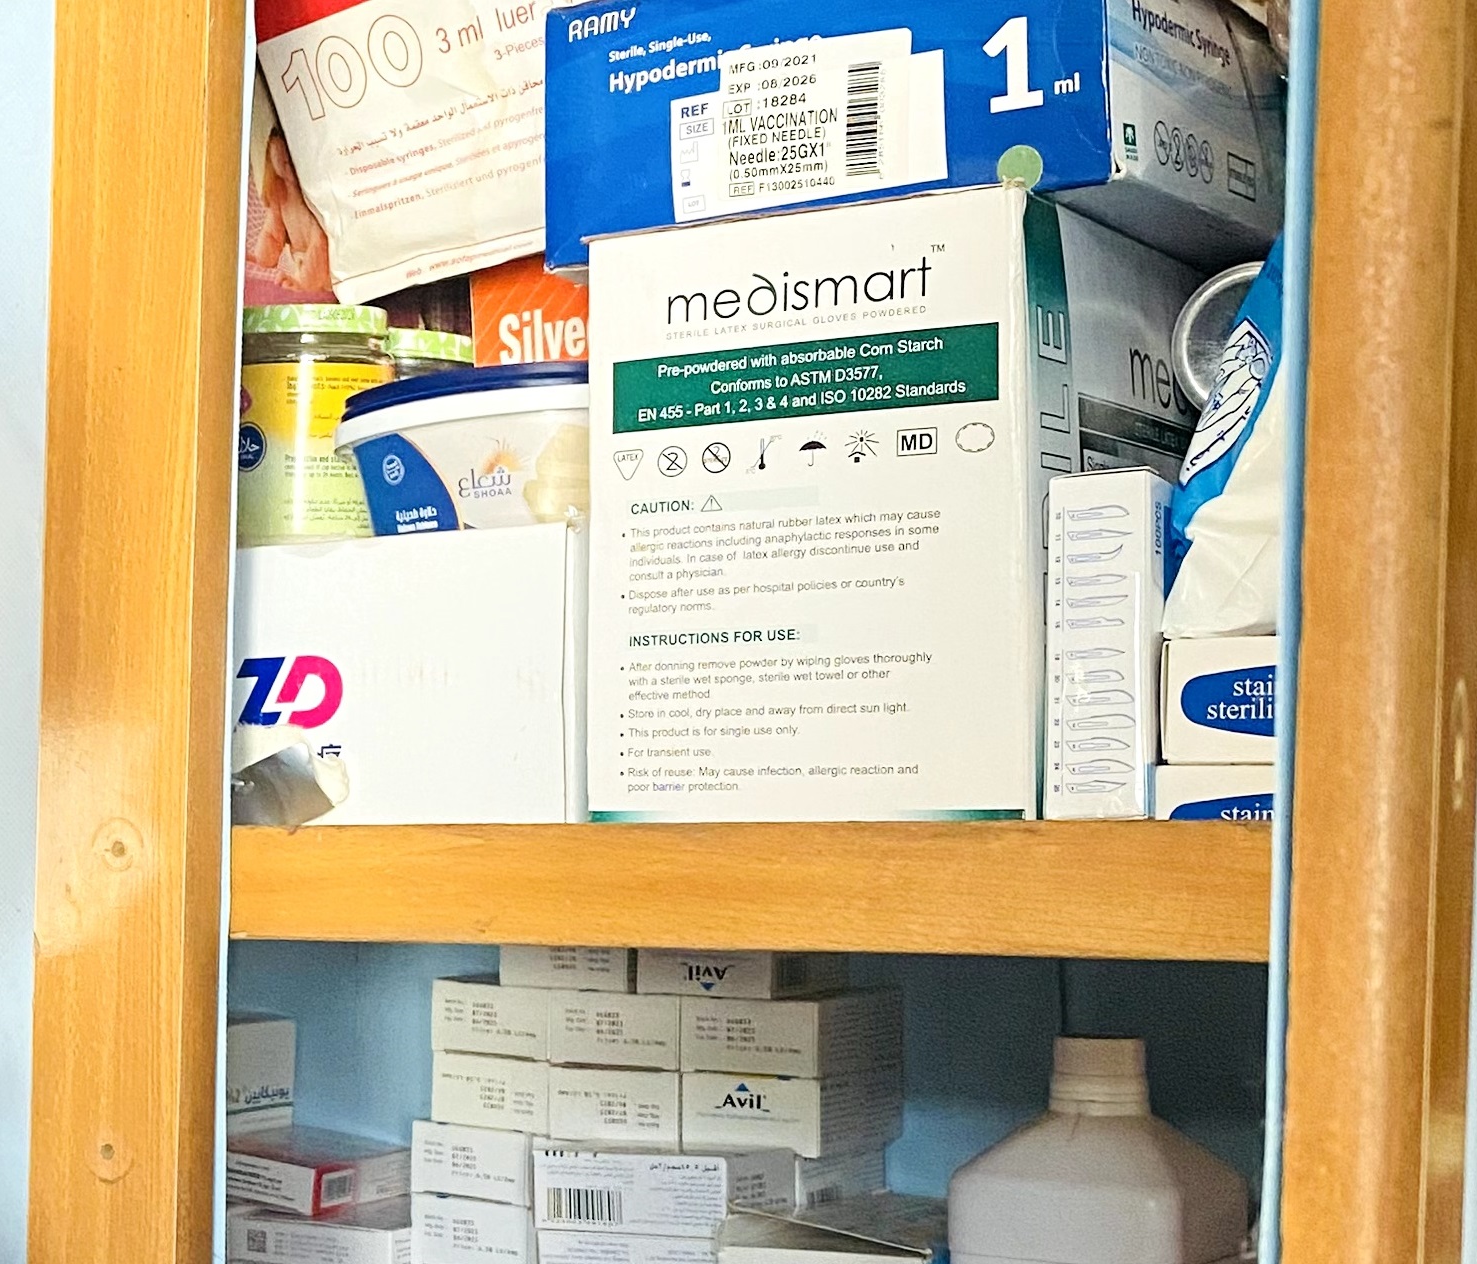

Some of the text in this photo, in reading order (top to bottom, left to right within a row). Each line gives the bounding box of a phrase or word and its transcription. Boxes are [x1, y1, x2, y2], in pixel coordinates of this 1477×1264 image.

[435, 2, 536, 54] 3 ml luer
[568, 7, 637, 43] RAMY
[608, 45, 647, 63] Sterile,
[648, 32, 712, 53] Single-Use,
[281, 14, 423, 121] 100
[609, 49, 724, 95] Hypodermi
[728, 61, 756, 75] MFG
[982, 16, 1044, 114] 1
[1053, 71, 1081, 96] ml
[727, 82, 751, 95] EXP
[680, 103, 709, 119] REF
[727, 102, 751, 115] LOT
[750, 107, 838, 132] VACCINATION
[685, 124, 709, 135] SIZE
[727, 126, 827, 150] (FIXED NEEDLE)
[733, 185, 753, 195] REF
[667, 255, 932, 325] medismart
[665, 305, 927, 341] STERILE LATEX SURGICAL GLOVES POWDERED
[657, 336, 944, 378] Pre-powdered with absorbable Corn Starch
[710, 365, 883, 395] Conforms to ASTM D3577,
[637, 380, 967, 423] EN 455 Part 1, 2, 3 & 4 and ISO 10282 Standards
[900, 432, 934, 452] MD
[458, 466, 511, 498] شعاع
[473, 487, 512, 499] SHOAA
[630, 499, 695, 516] CAUTION:
[630, 509, 942, 539] This product contains natural rubber latex which may cause
[629, 628, 801, 647] INSTRUCTIONS FOR USE:
[628, 661, 653, 672] After
[654, 661, 695, 673] donning
[697, 659, 737, 670] remove
[739, 658, 778, 670] powder
[781, 657, 794, 669] by
[834, 654, 870, 667] gloves
[873, 651, 933, 665] thoroughly
[628, 708, 655, 719] Store
[657, 709, 666, 718] in
[668, 707, 693, 719] cool,
[695, 706, 712, 719] dry
[714, 705, 742, 719] place
[745, 705, 765, 716] and
[768, 705, 797, 717] away
[799, 704, 824, 715] from
[826, 703, 858, 714] direct
[859, 704, 881, 713] sun
[628, 727, 650, 738] This
[652, 726, 690, 739] product
[692, 726, 701, 736] is
[703, 726, 717, 736] for
[719, 725, 751, 738] single
[753, 726, 773, 735] use
[627, 747, 645, 758] For
[646, 747, 690, 757] transient
[722, 1093, 762, 1110] Avil
